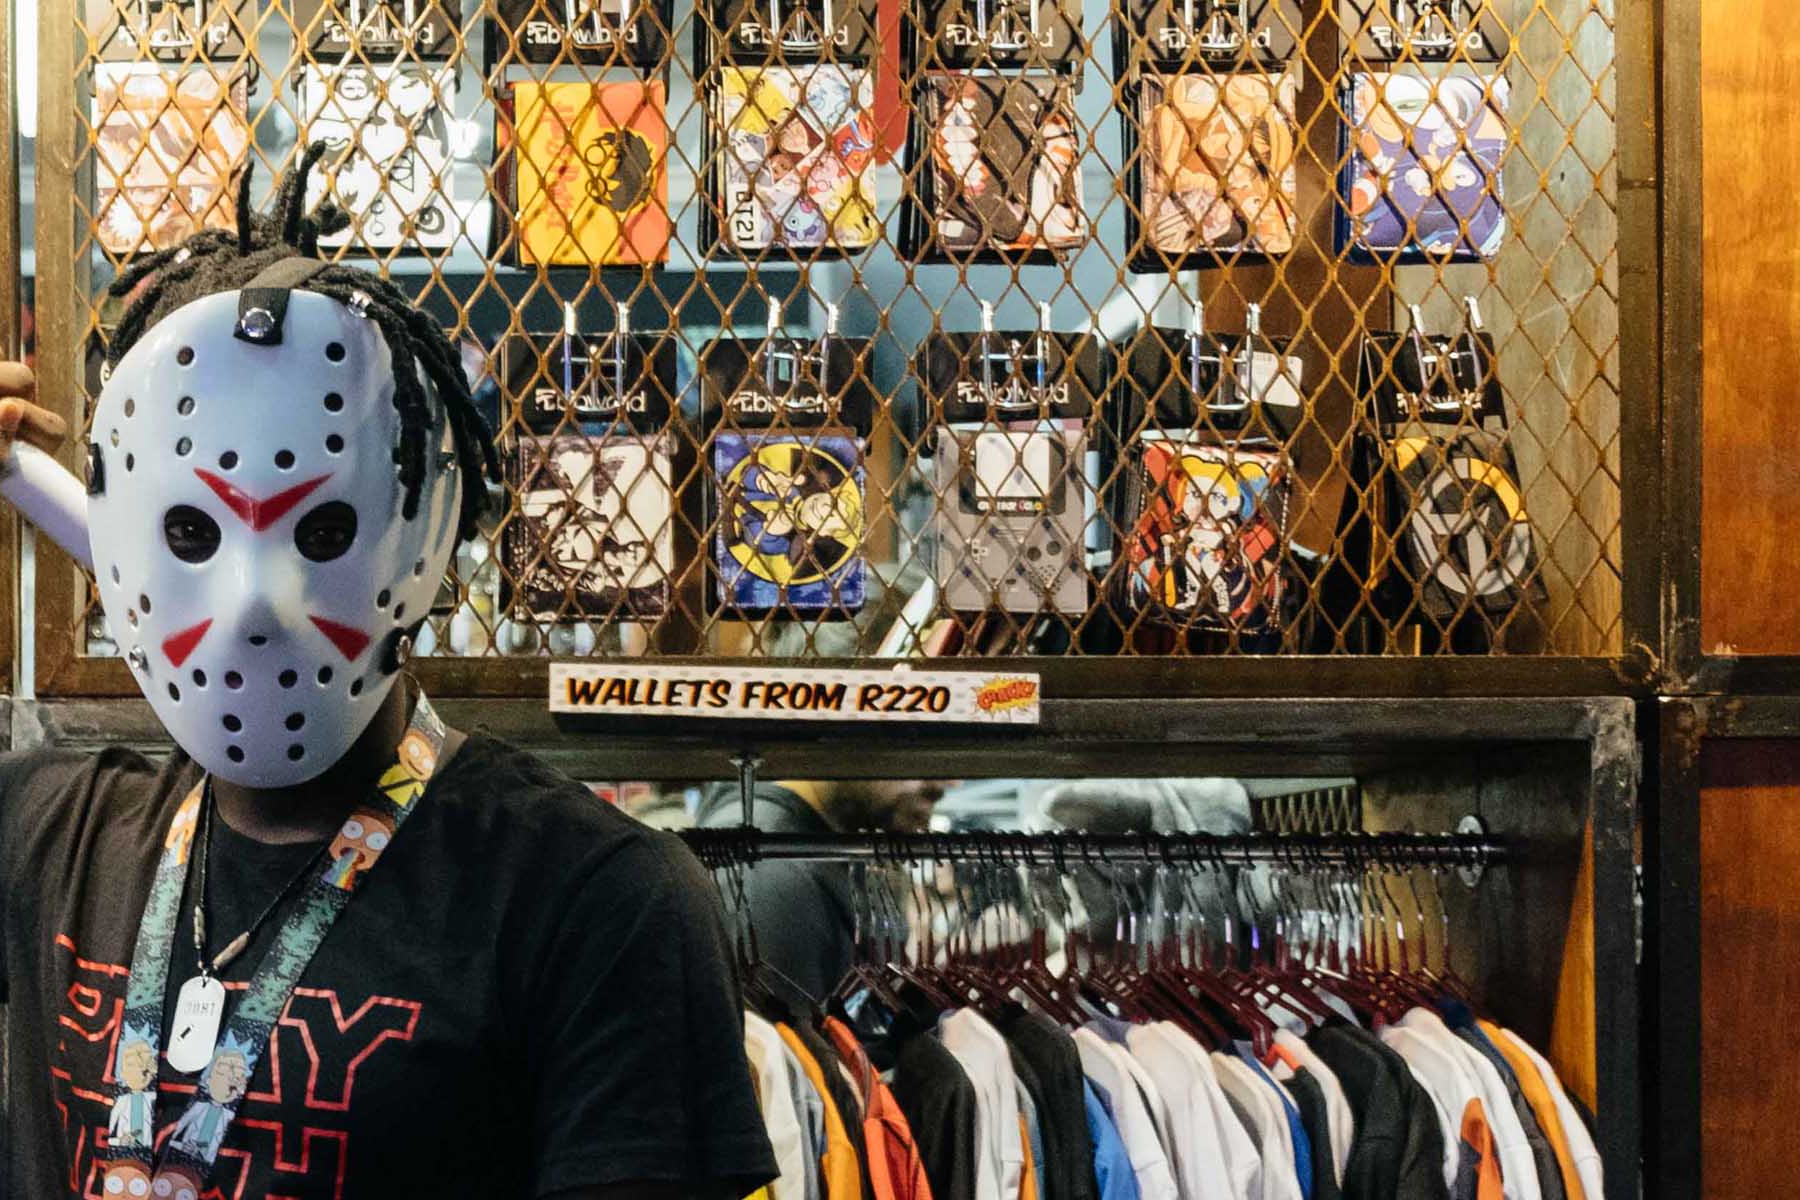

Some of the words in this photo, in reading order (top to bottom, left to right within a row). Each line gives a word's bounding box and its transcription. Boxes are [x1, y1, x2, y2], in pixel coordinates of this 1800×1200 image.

[548, 23, 638, 45] bwod
[762, 24, 850, 46] bowod
[736, 191, 755, 241] BT21
[754, 391, 843, 415] biood
[566, 677, 731, 708] WALLETS
[740, 680, 848, 710] FROM
[857, 683, 951, 713] R220
